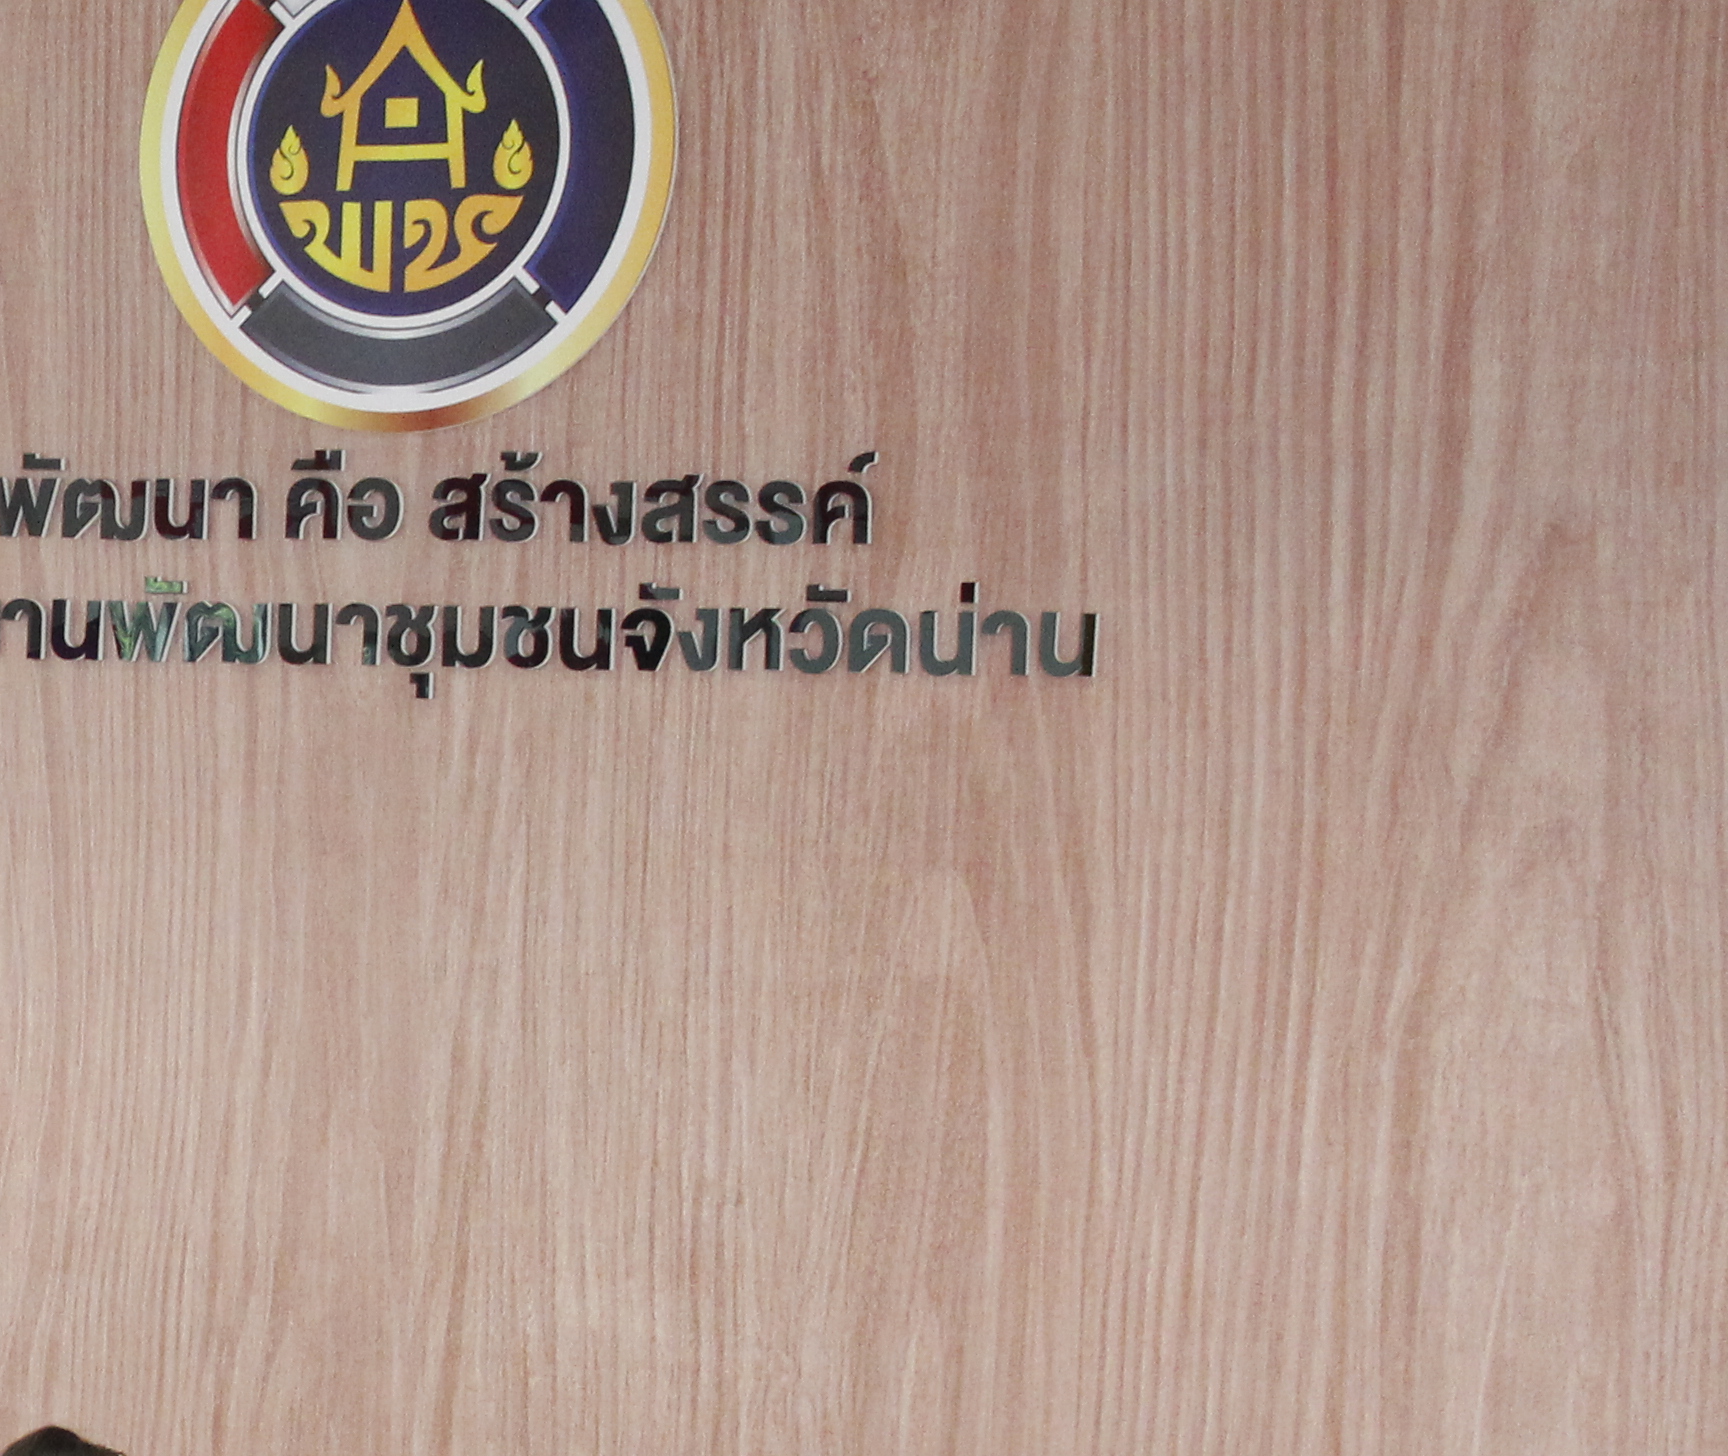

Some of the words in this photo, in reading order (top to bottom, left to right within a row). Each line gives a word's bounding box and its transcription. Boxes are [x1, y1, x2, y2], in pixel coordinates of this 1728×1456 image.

[284, 448, 404, 543] คือ
[429, 450, 878, 547] สร้างสรรค์
